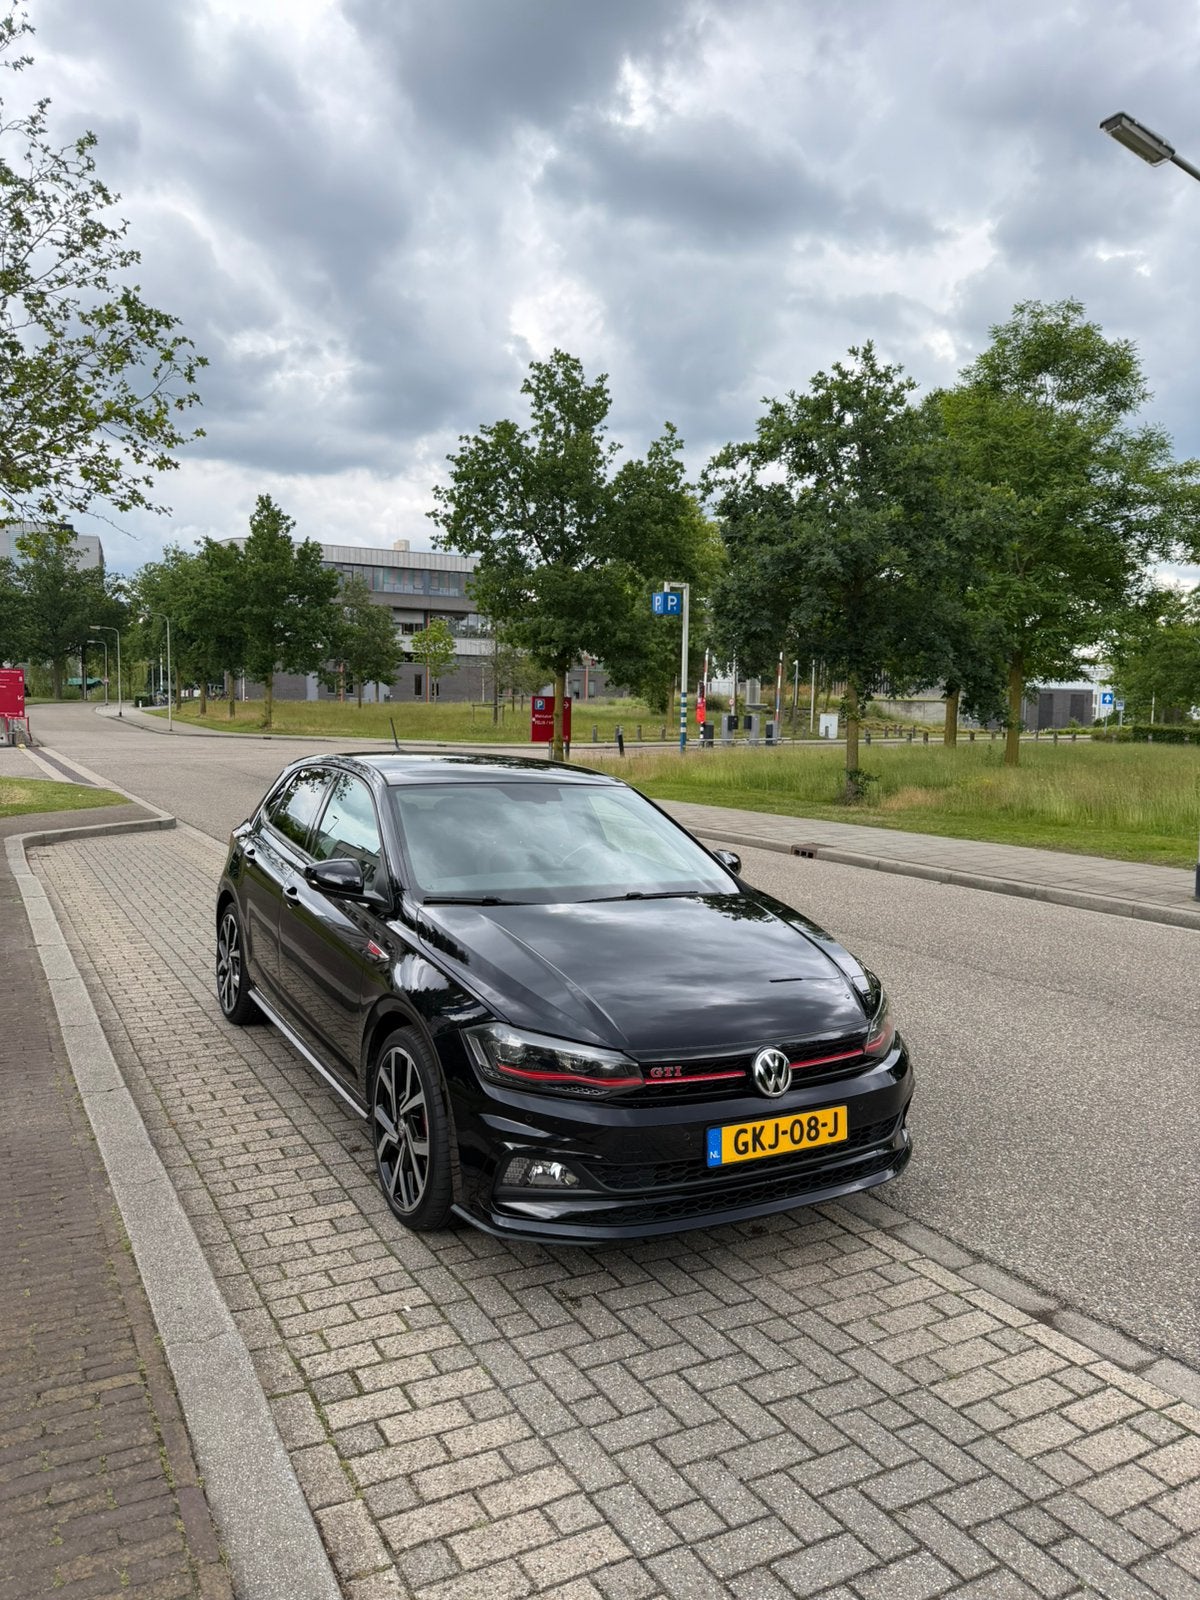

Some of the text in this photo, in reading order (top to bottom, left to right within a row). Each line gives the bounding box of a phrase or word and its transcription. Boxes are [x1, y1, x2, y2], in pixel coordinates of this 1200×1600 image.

[655, 595, 662, 611] P
[667, 595, 677, 611] P
[650, 1066, 682, 1077] GTI
[755, 1048, 791, 1097] VW
[733, 1111, 839, 1156] GKJ-08-J
[709, 1151, 720, 1159] NL
